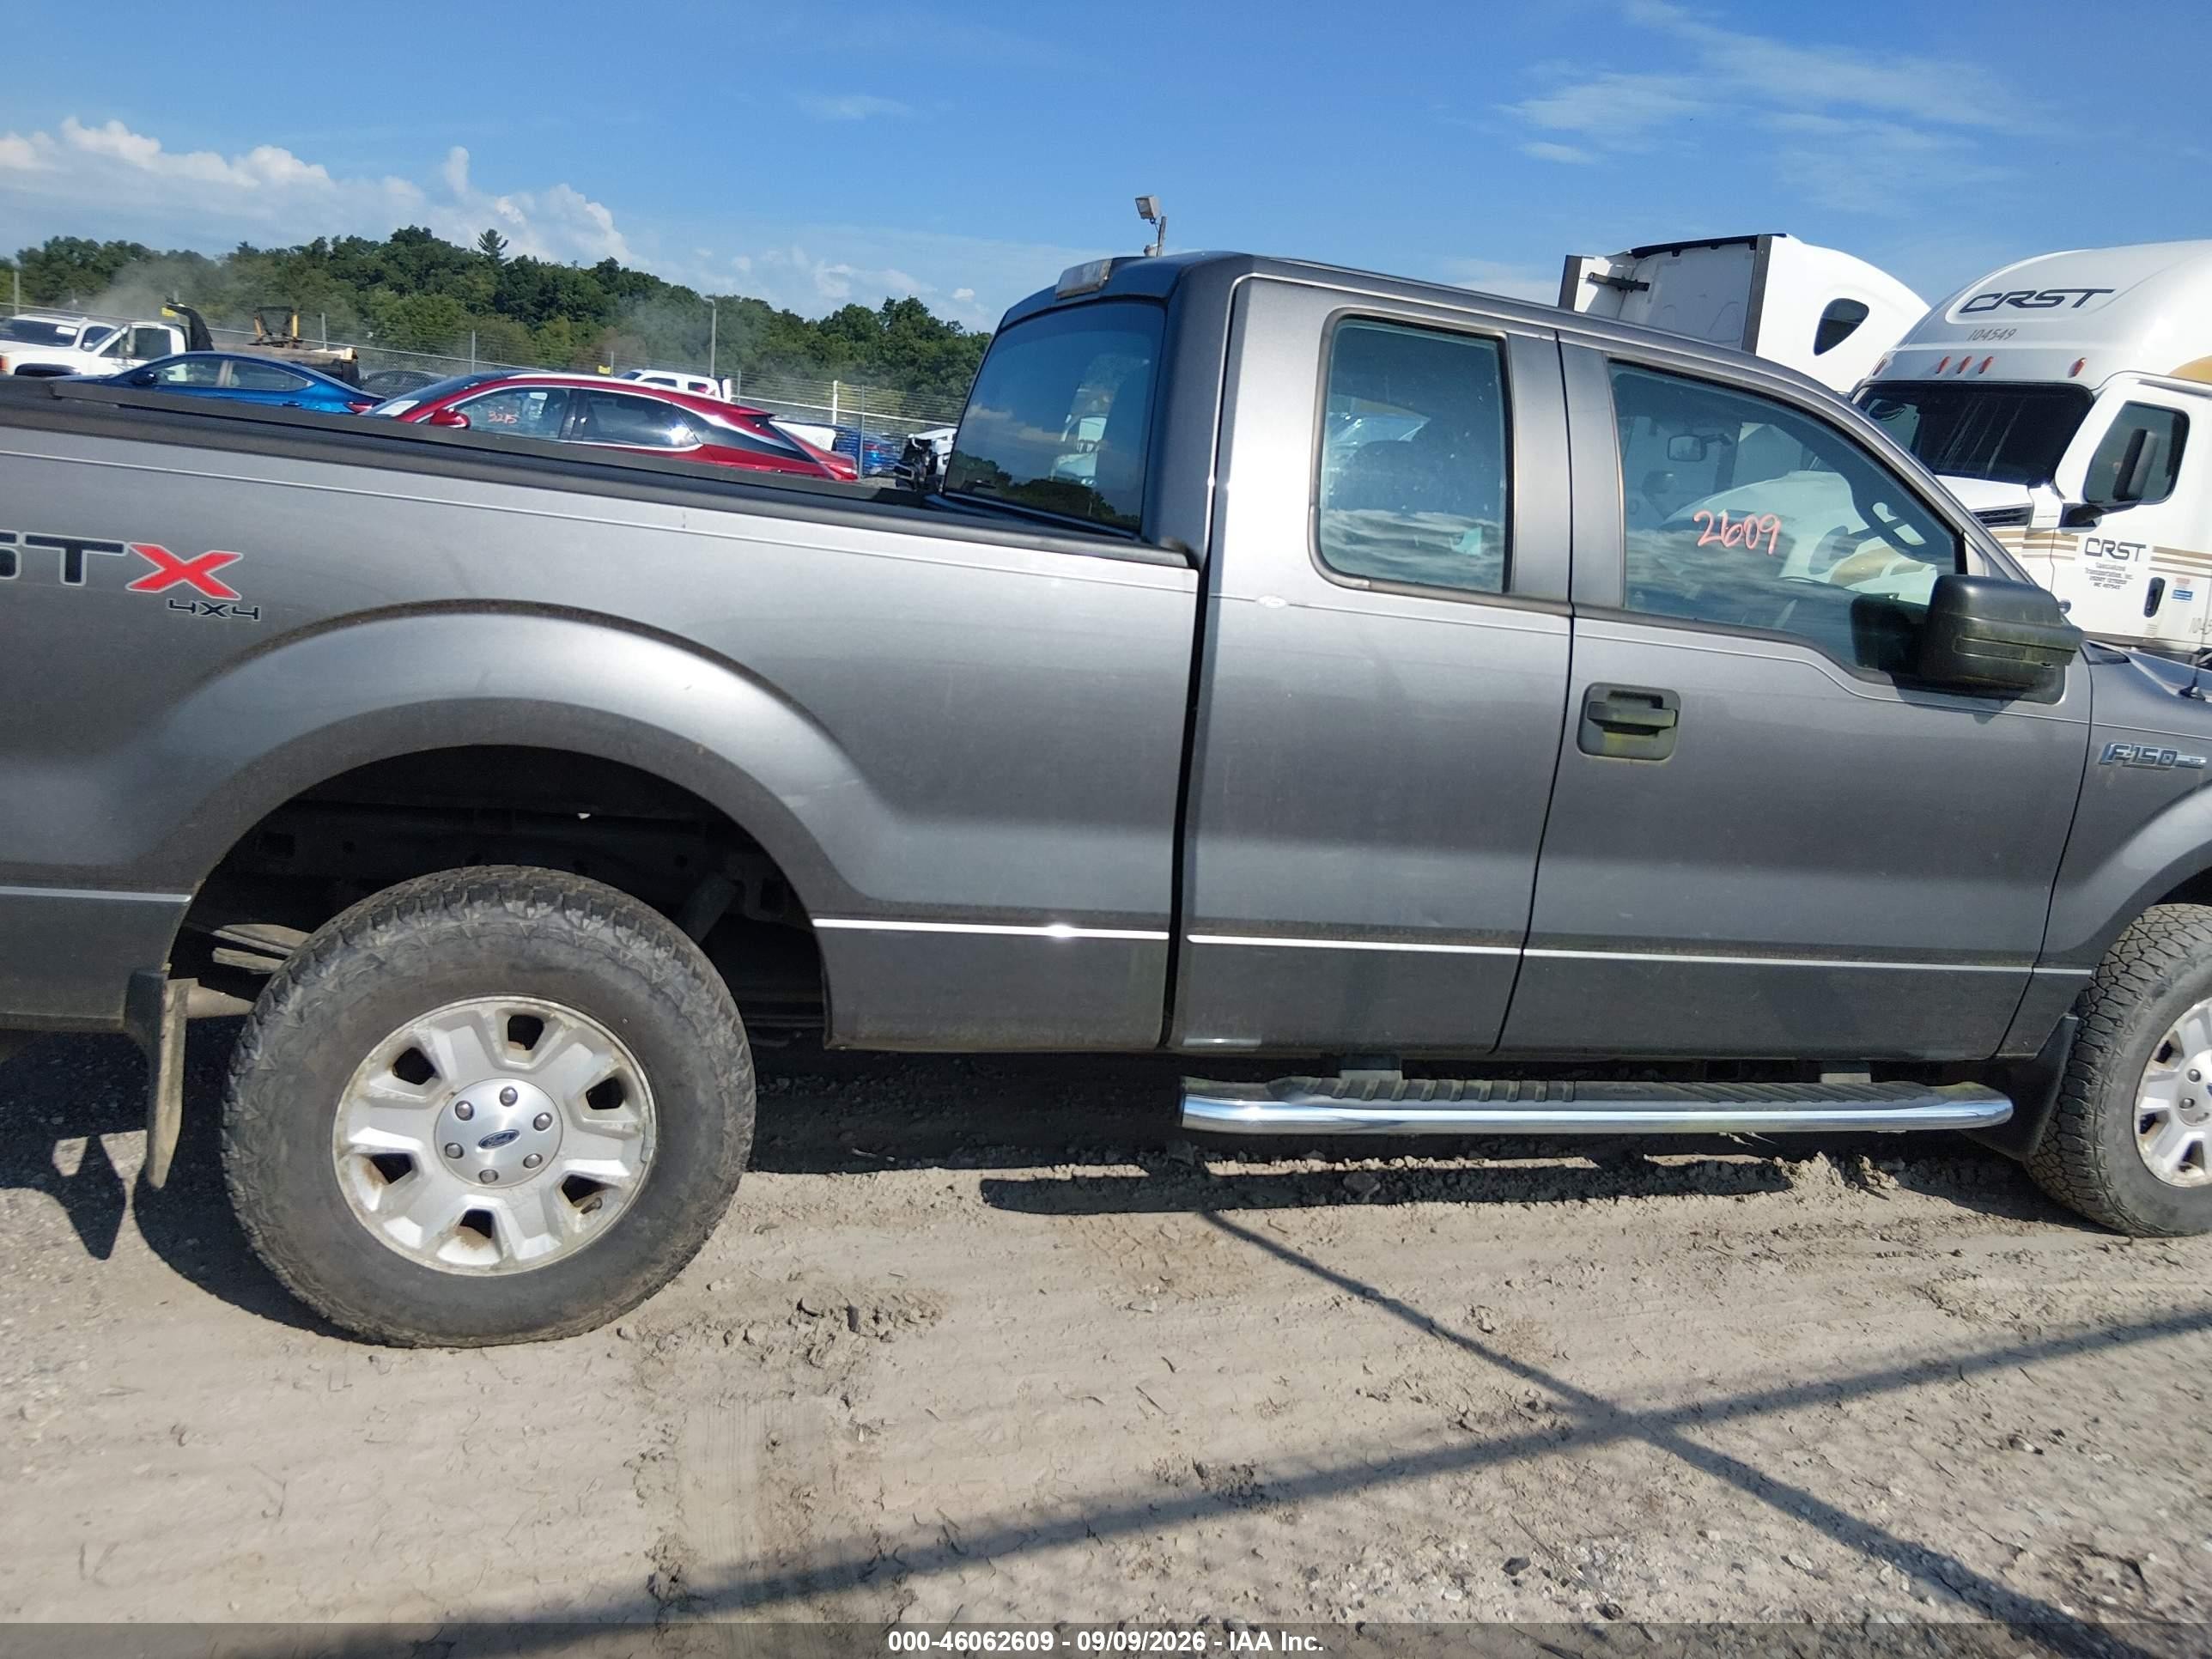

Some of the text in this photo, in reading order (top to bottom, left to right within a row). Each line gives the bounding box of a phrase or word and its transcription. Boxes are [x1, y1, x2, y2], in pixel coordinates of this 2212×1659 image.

[1959, 289, 2116, 313] CRST
[1966, 328, 2018, 342] 104549
[1693, 509, 1781, 555] 2609
[2085, 537, 2147, 562] CRST
[0, 529, 243, 600] TX
